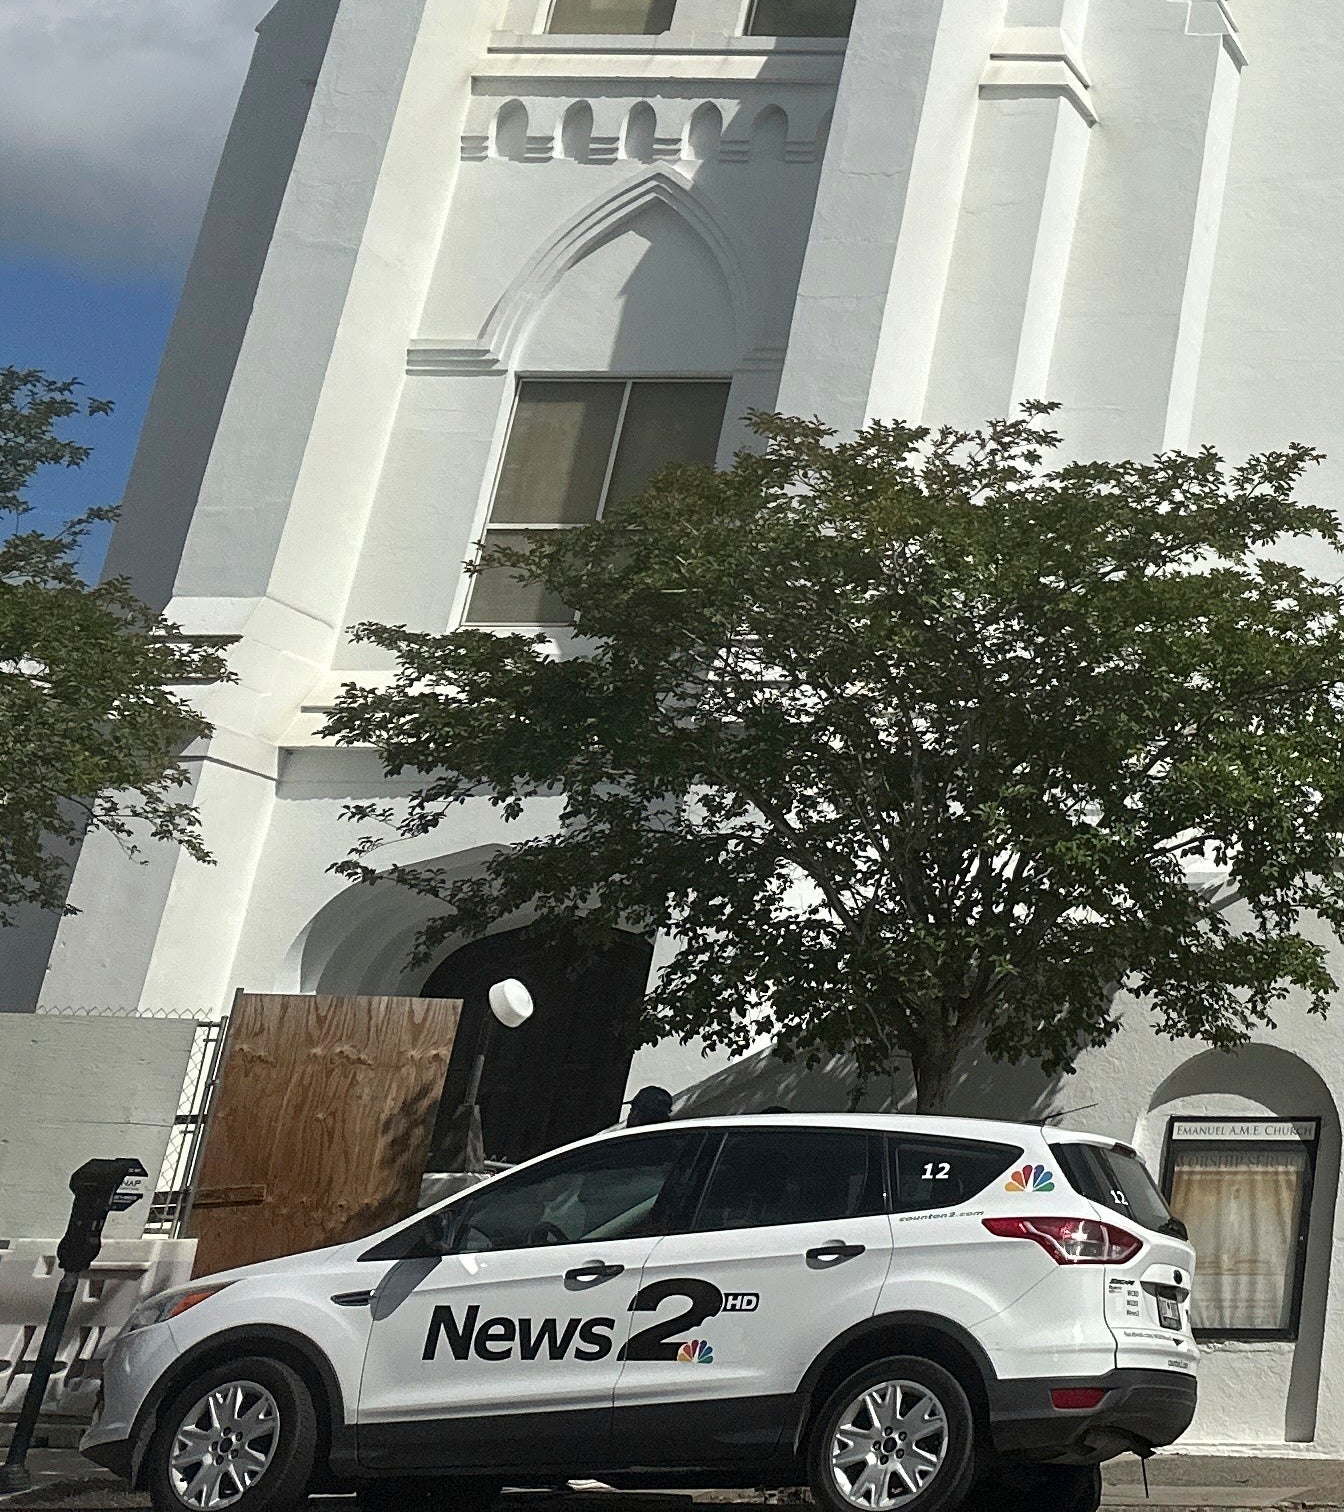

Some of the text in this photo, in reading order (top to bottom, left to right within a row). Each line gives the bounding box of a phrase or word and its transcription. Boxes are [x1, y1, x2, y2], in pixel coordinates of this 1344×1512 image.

[1176, 1124, 1225, 1136] EMANUEL
[1264, 1124, 1312, 1136] CHURCH
[921, 1162, 950, 1179] 12
[1110, 1189, 1129, 1206] 12
[898, 1210, 984, 1222] counton2.com
[422, 1277, 758, 1362] News 2 HD
